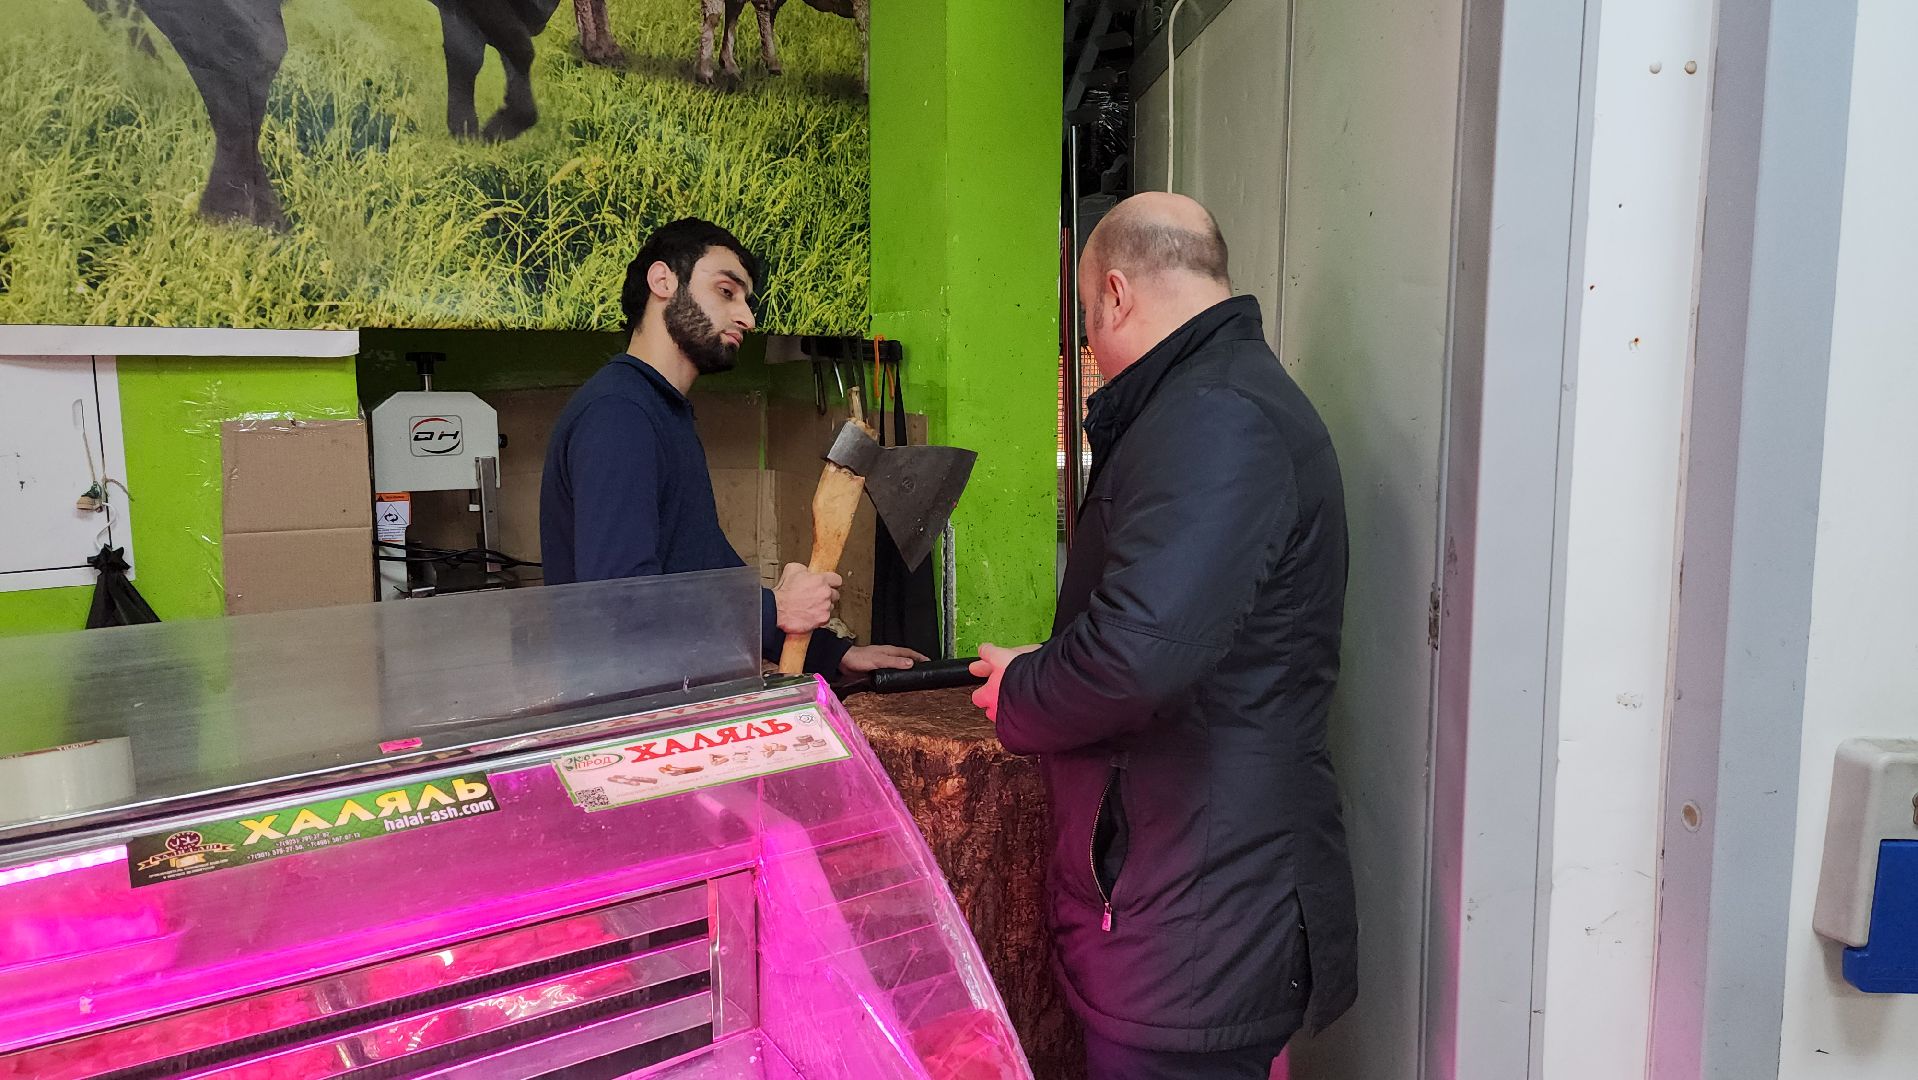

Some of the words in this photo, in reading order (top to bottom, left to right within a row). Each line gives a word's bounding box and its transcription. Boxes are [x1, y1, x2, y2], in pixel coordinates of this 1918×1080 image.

[624, 718, 793, 763] ХАЛЯЛЬ
[238, 778, 488, 846] ХАЛЯЛЬ
[383, 799, 496, 832] halal-ash.com
